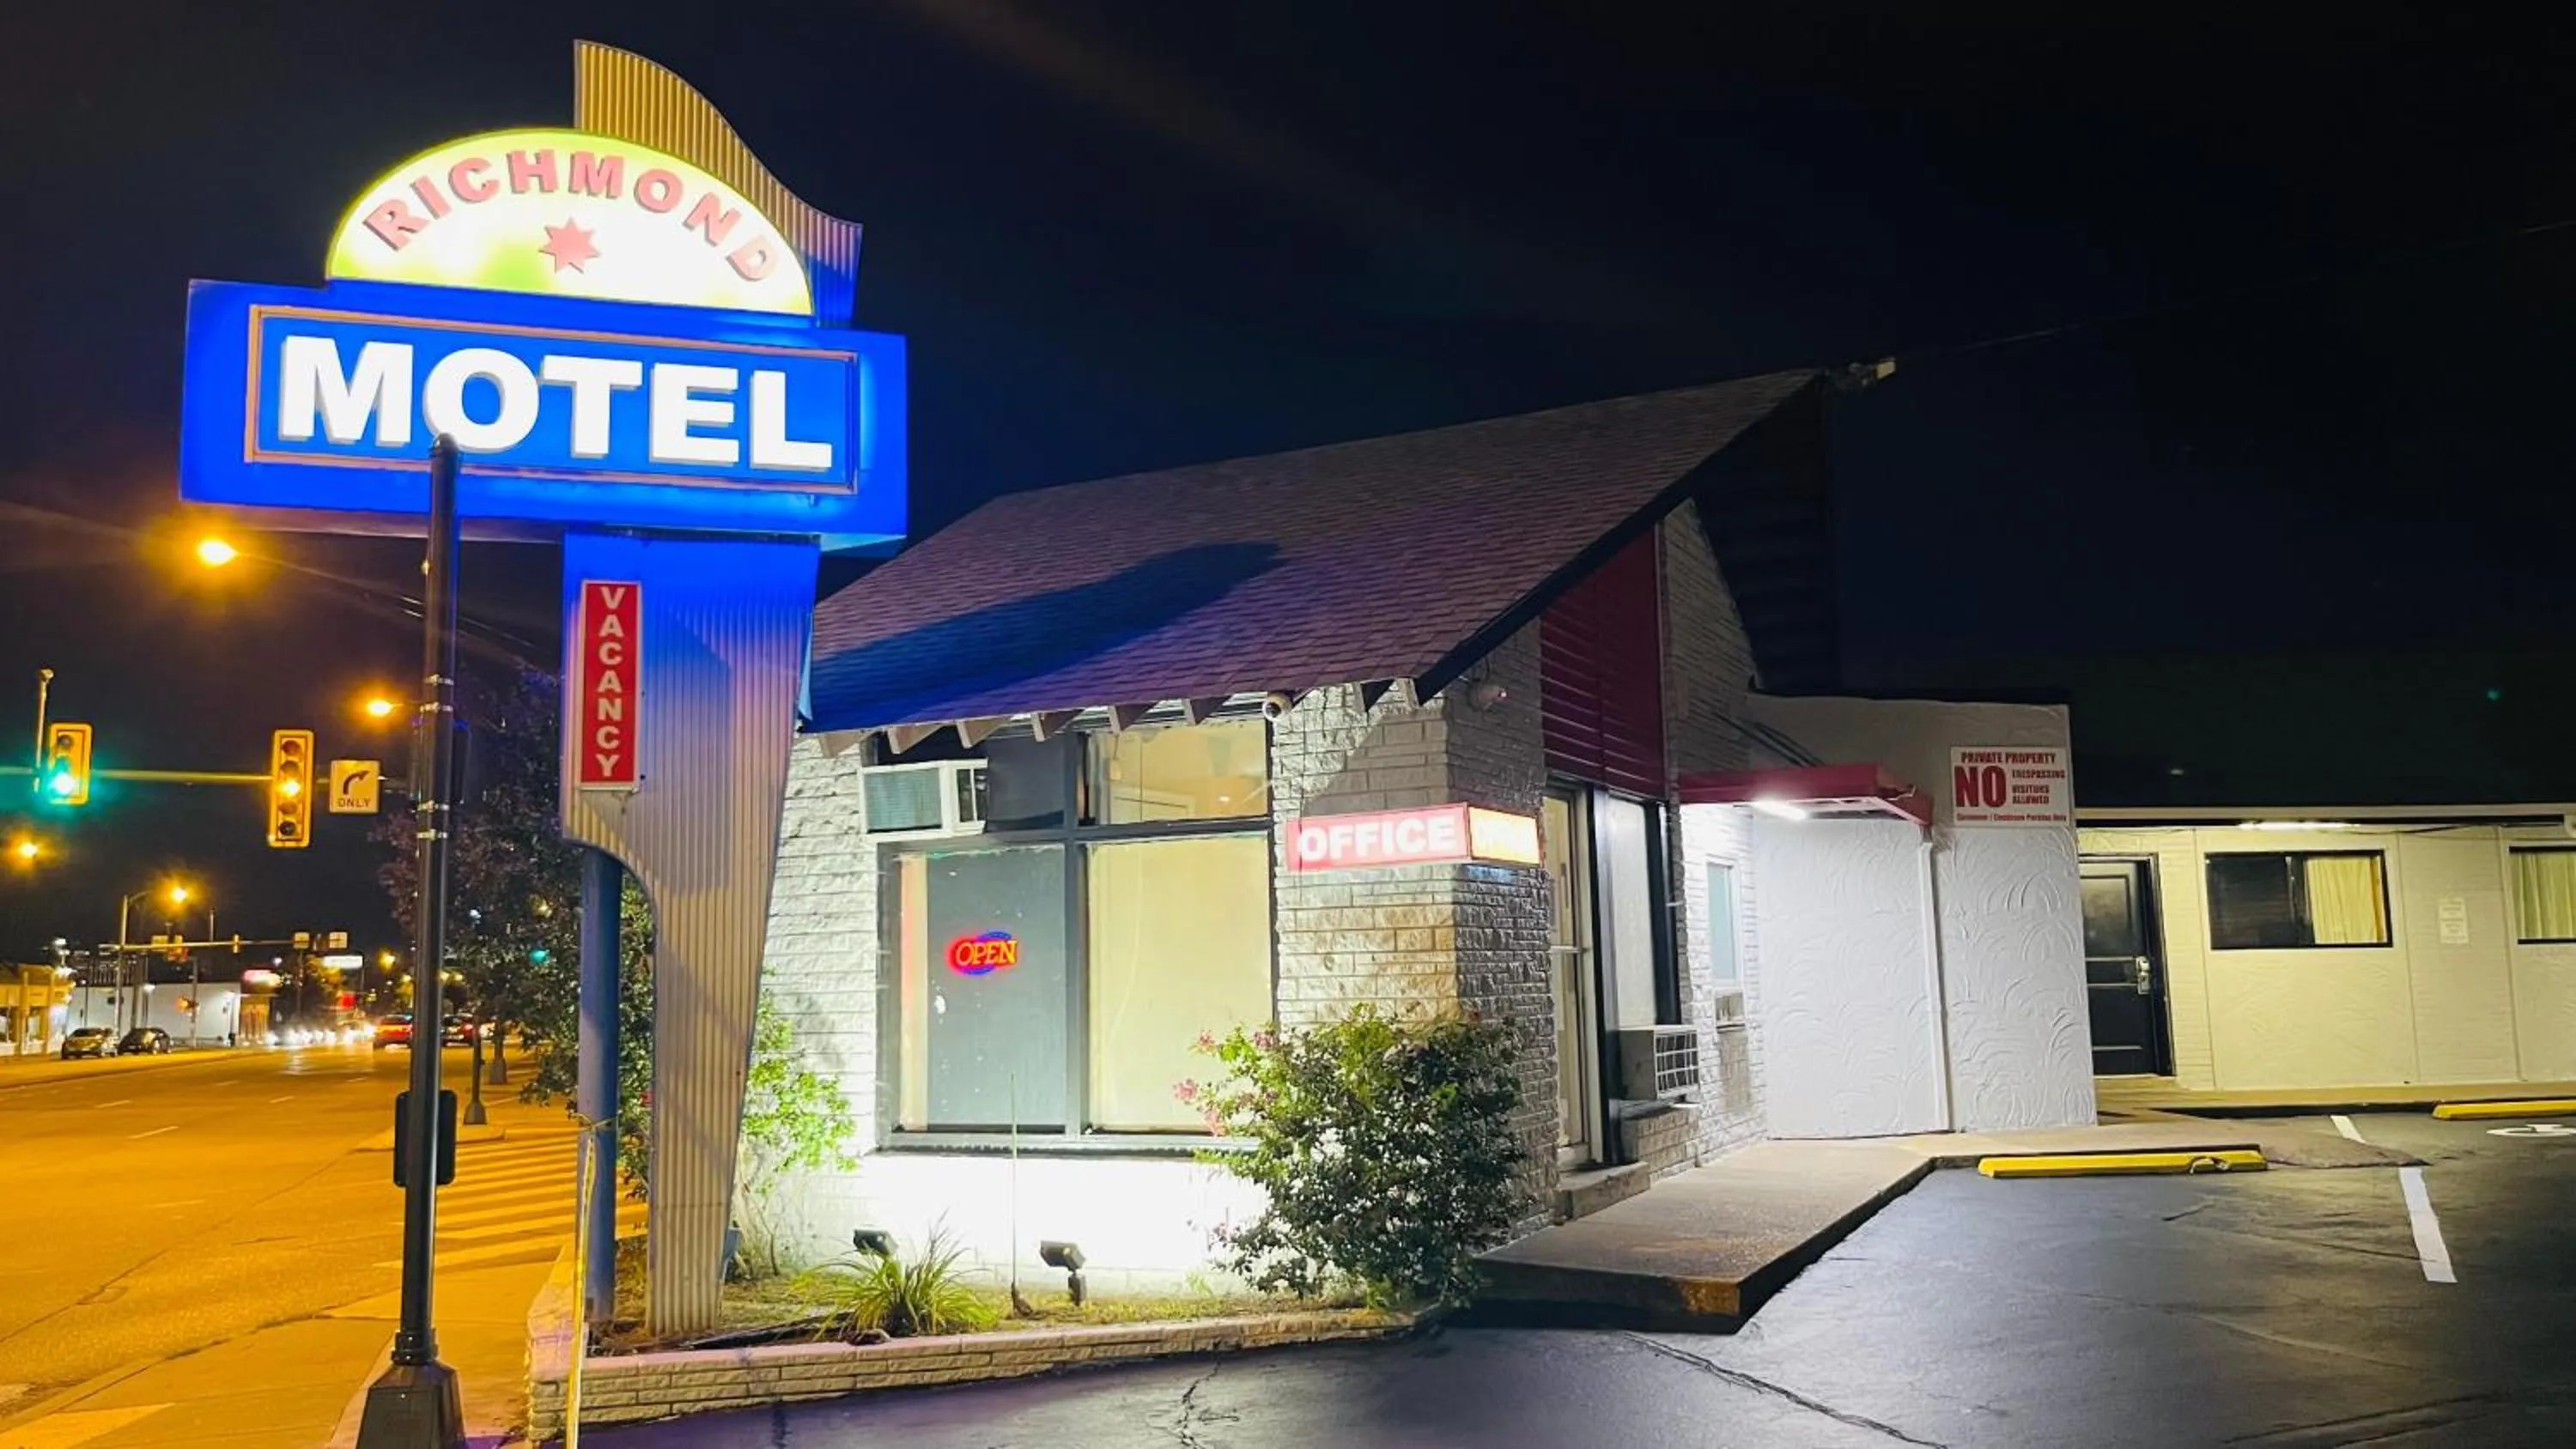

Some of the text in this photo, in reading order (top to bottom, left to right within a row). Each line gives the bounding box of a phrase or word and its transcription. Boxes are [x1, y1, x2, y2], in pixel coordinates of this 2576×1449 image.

[362, 149, 779, 283] RICHMOND
[279, 335, 833, 471] MOTEL
[595, 586, 626, 777] VACANCY
[1960, 752, 2057, 764] PRIVATE PROPERTY
[337, 797, 371, 808] ONLY
[1953, 765, 2007, 808] NO
[1298, 815, 1458, 861] OFFICE
[955, 940, 1018, 966] OPEN
